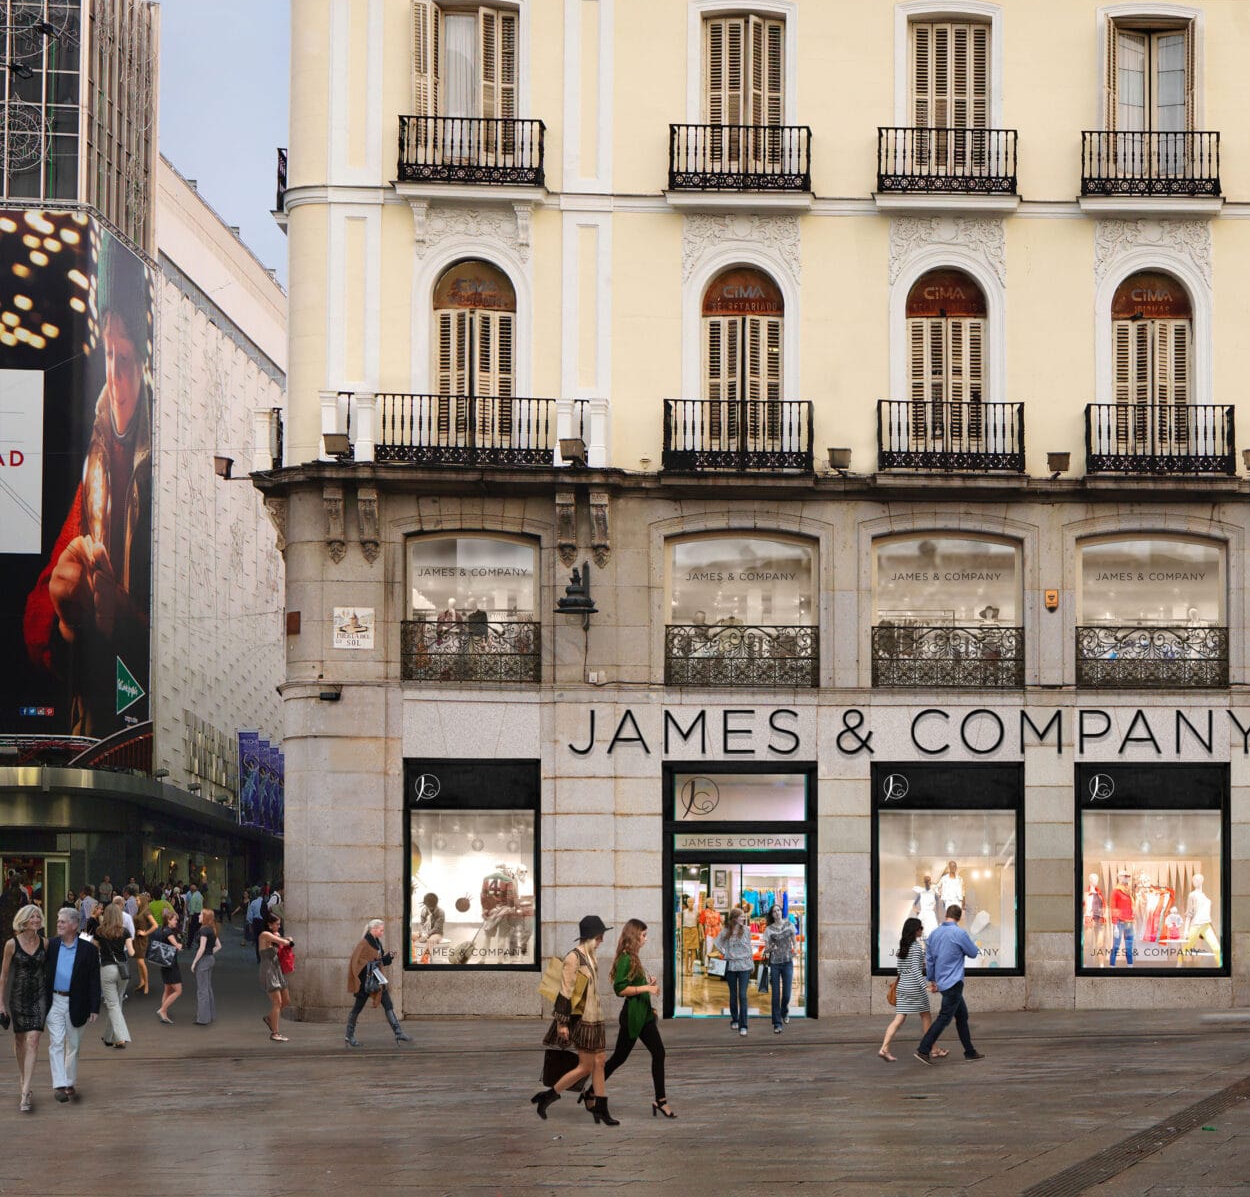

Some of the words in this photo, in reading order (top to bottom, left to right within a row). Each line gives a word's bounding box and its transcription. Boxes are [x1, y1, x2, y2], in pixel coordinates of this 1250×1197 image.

[418, 568, 455, 577] JAMES
[459, 568, 466, 577] &
[471, 568, 528, 577] COMPANY
[686, 572, 723, 581] JAMES
[727, 572, 735, 581] &
[739, 572, 796, 581] COMPANY
[891, 572, 928, 581] JAMES
[933, 572, 940, 581] &
[944, 572, 1001, 581] COMPANY
[1095, 572, 1133, 581] JAMES
[1137, 572, 1144, 581] &
[1148, 572, 1206, 581] COMPANY
[568, 708, 801, 755] JAMES
[836, 708, 874, 755] &
[682, 838, 722, 847] JAMES
[726, 838, 733, 847] &
[738, 838, 800, 847] COMPANY
[417, 948, 455, 957] JAMES
[1090, 948, 1128, 957] JAMES
[1132, 948, 1139, 957] &
